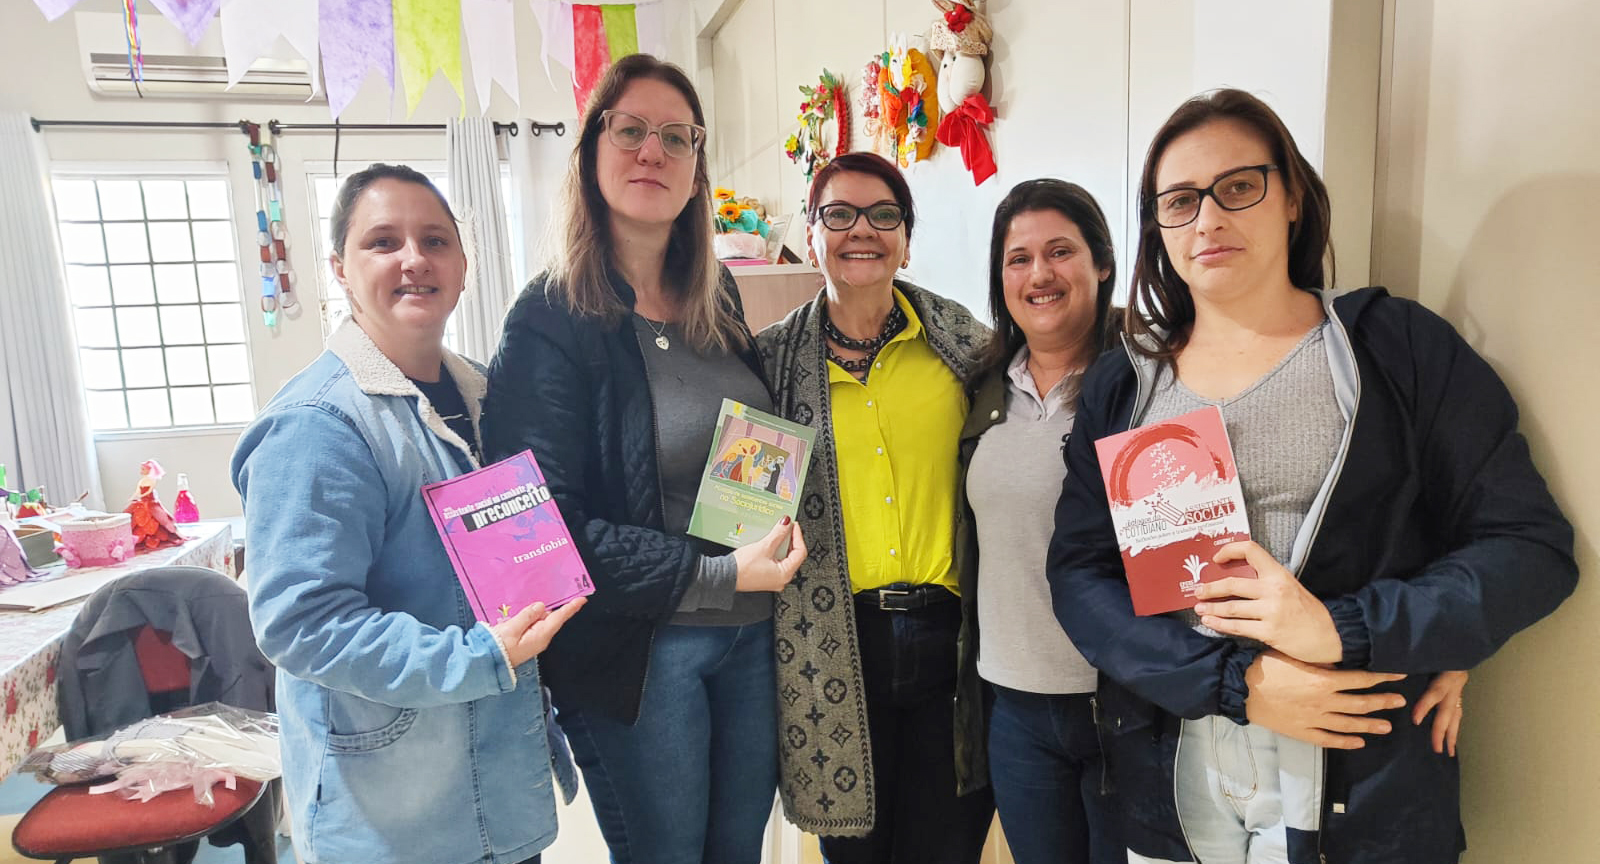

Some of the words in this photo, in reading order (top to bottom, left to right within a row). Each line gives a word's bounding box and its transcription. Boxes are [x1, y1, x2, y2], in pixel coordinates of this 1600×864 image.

[472, 485, 551, 529] preconceito
[475, 497, 493, 510] social
[500, 485, 526, 500] combate
[1185, 496, 1233, 511] ASSISTENTE
[1184, 501, 1236, 524] SOCIAL
[1126, 520, 1167, 539] COTIDIANO
[513, 537, 568, 564] transfobia
[582, 574, 591, 588] 4
